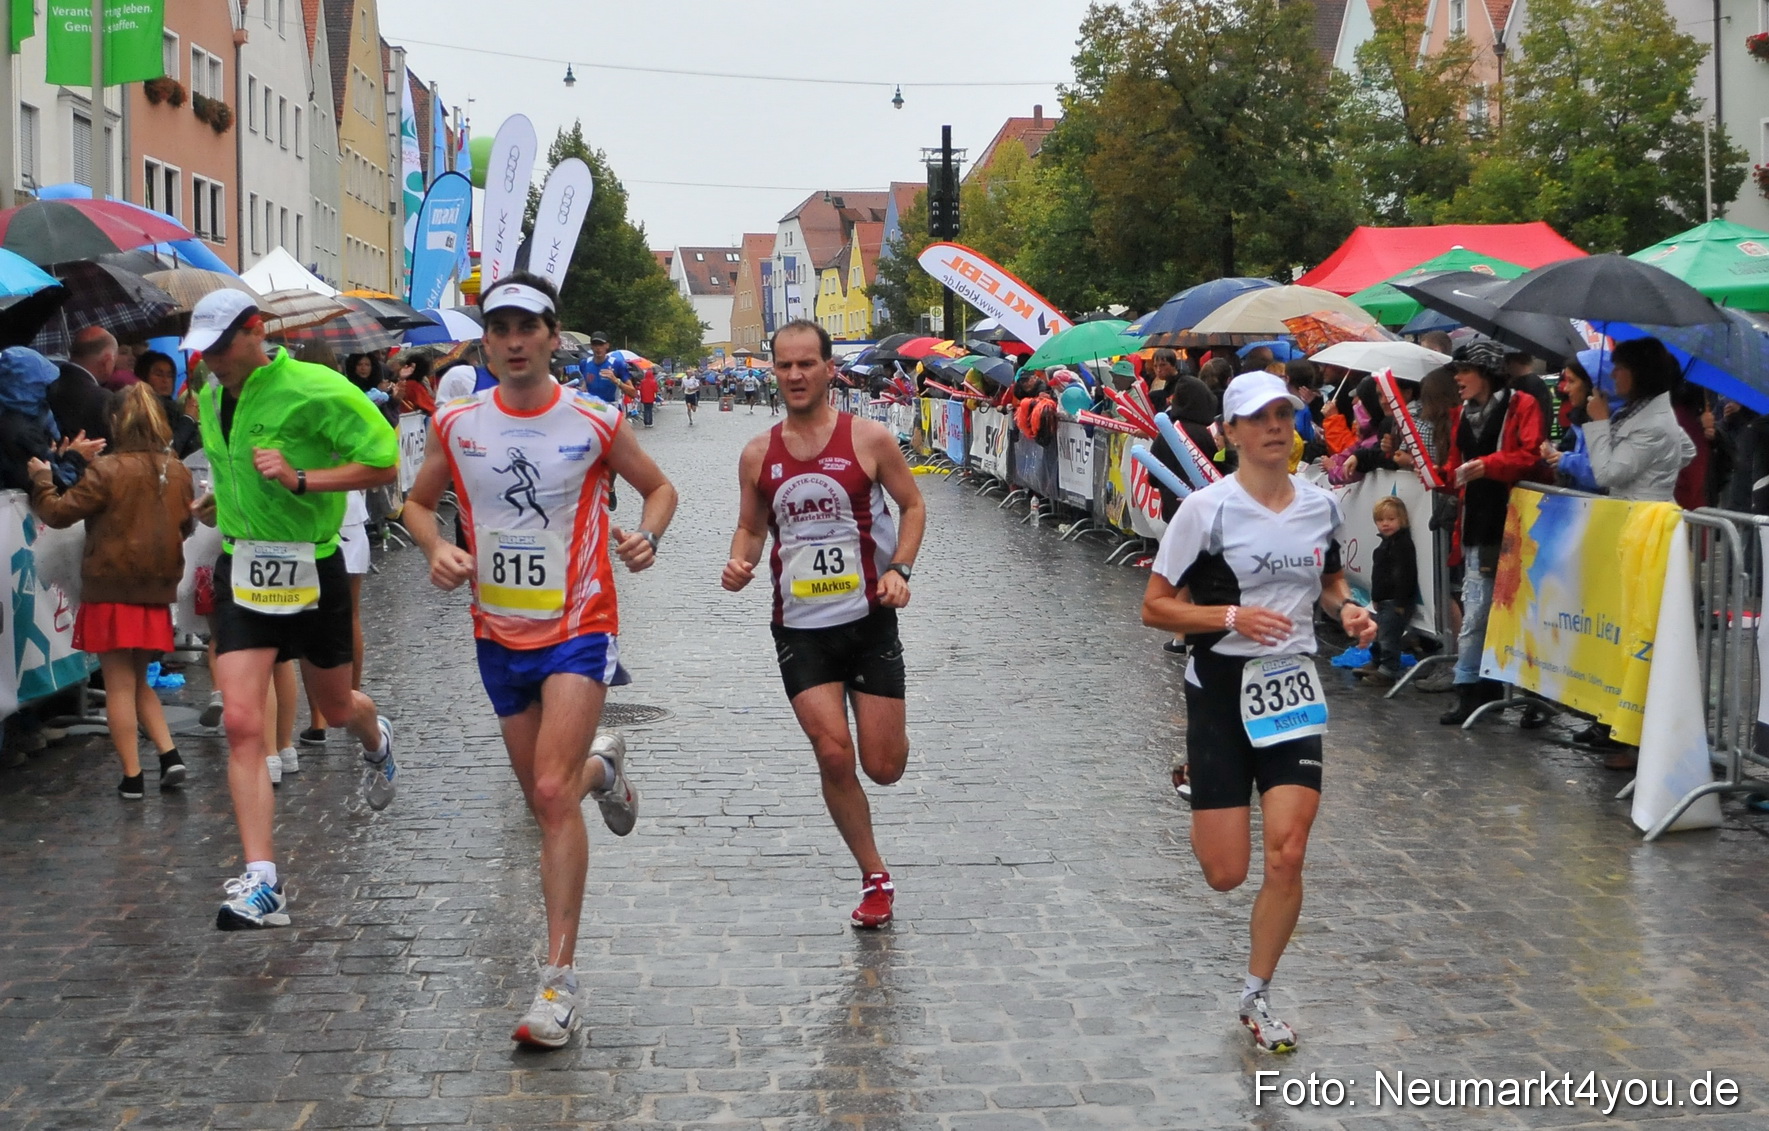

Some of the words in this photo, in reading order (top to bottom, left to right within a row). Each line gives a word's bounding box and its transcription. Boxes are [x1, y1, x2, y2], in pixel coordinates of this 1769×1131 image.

[123, 4, 153, 15] leben.
[495, 208, 508, 253] BKK
[546, 237, 561, 273] BKK
[787, 498, 833, 516] LAC
[793, 513, 831, 523] Harlekin
[250, 560, 298, 587] 627
[493, 552, 546, 586] 815
[813, 547, 845, 575] 43
[1251, 547, 1322, 575] Xplus1
[251, 592, 299, 603] Matthias
[812, 580, 851, 594] MArkus
[1245, 670, 1315, 716] 3338
[1274, 710, 1309, 731] Astrid
